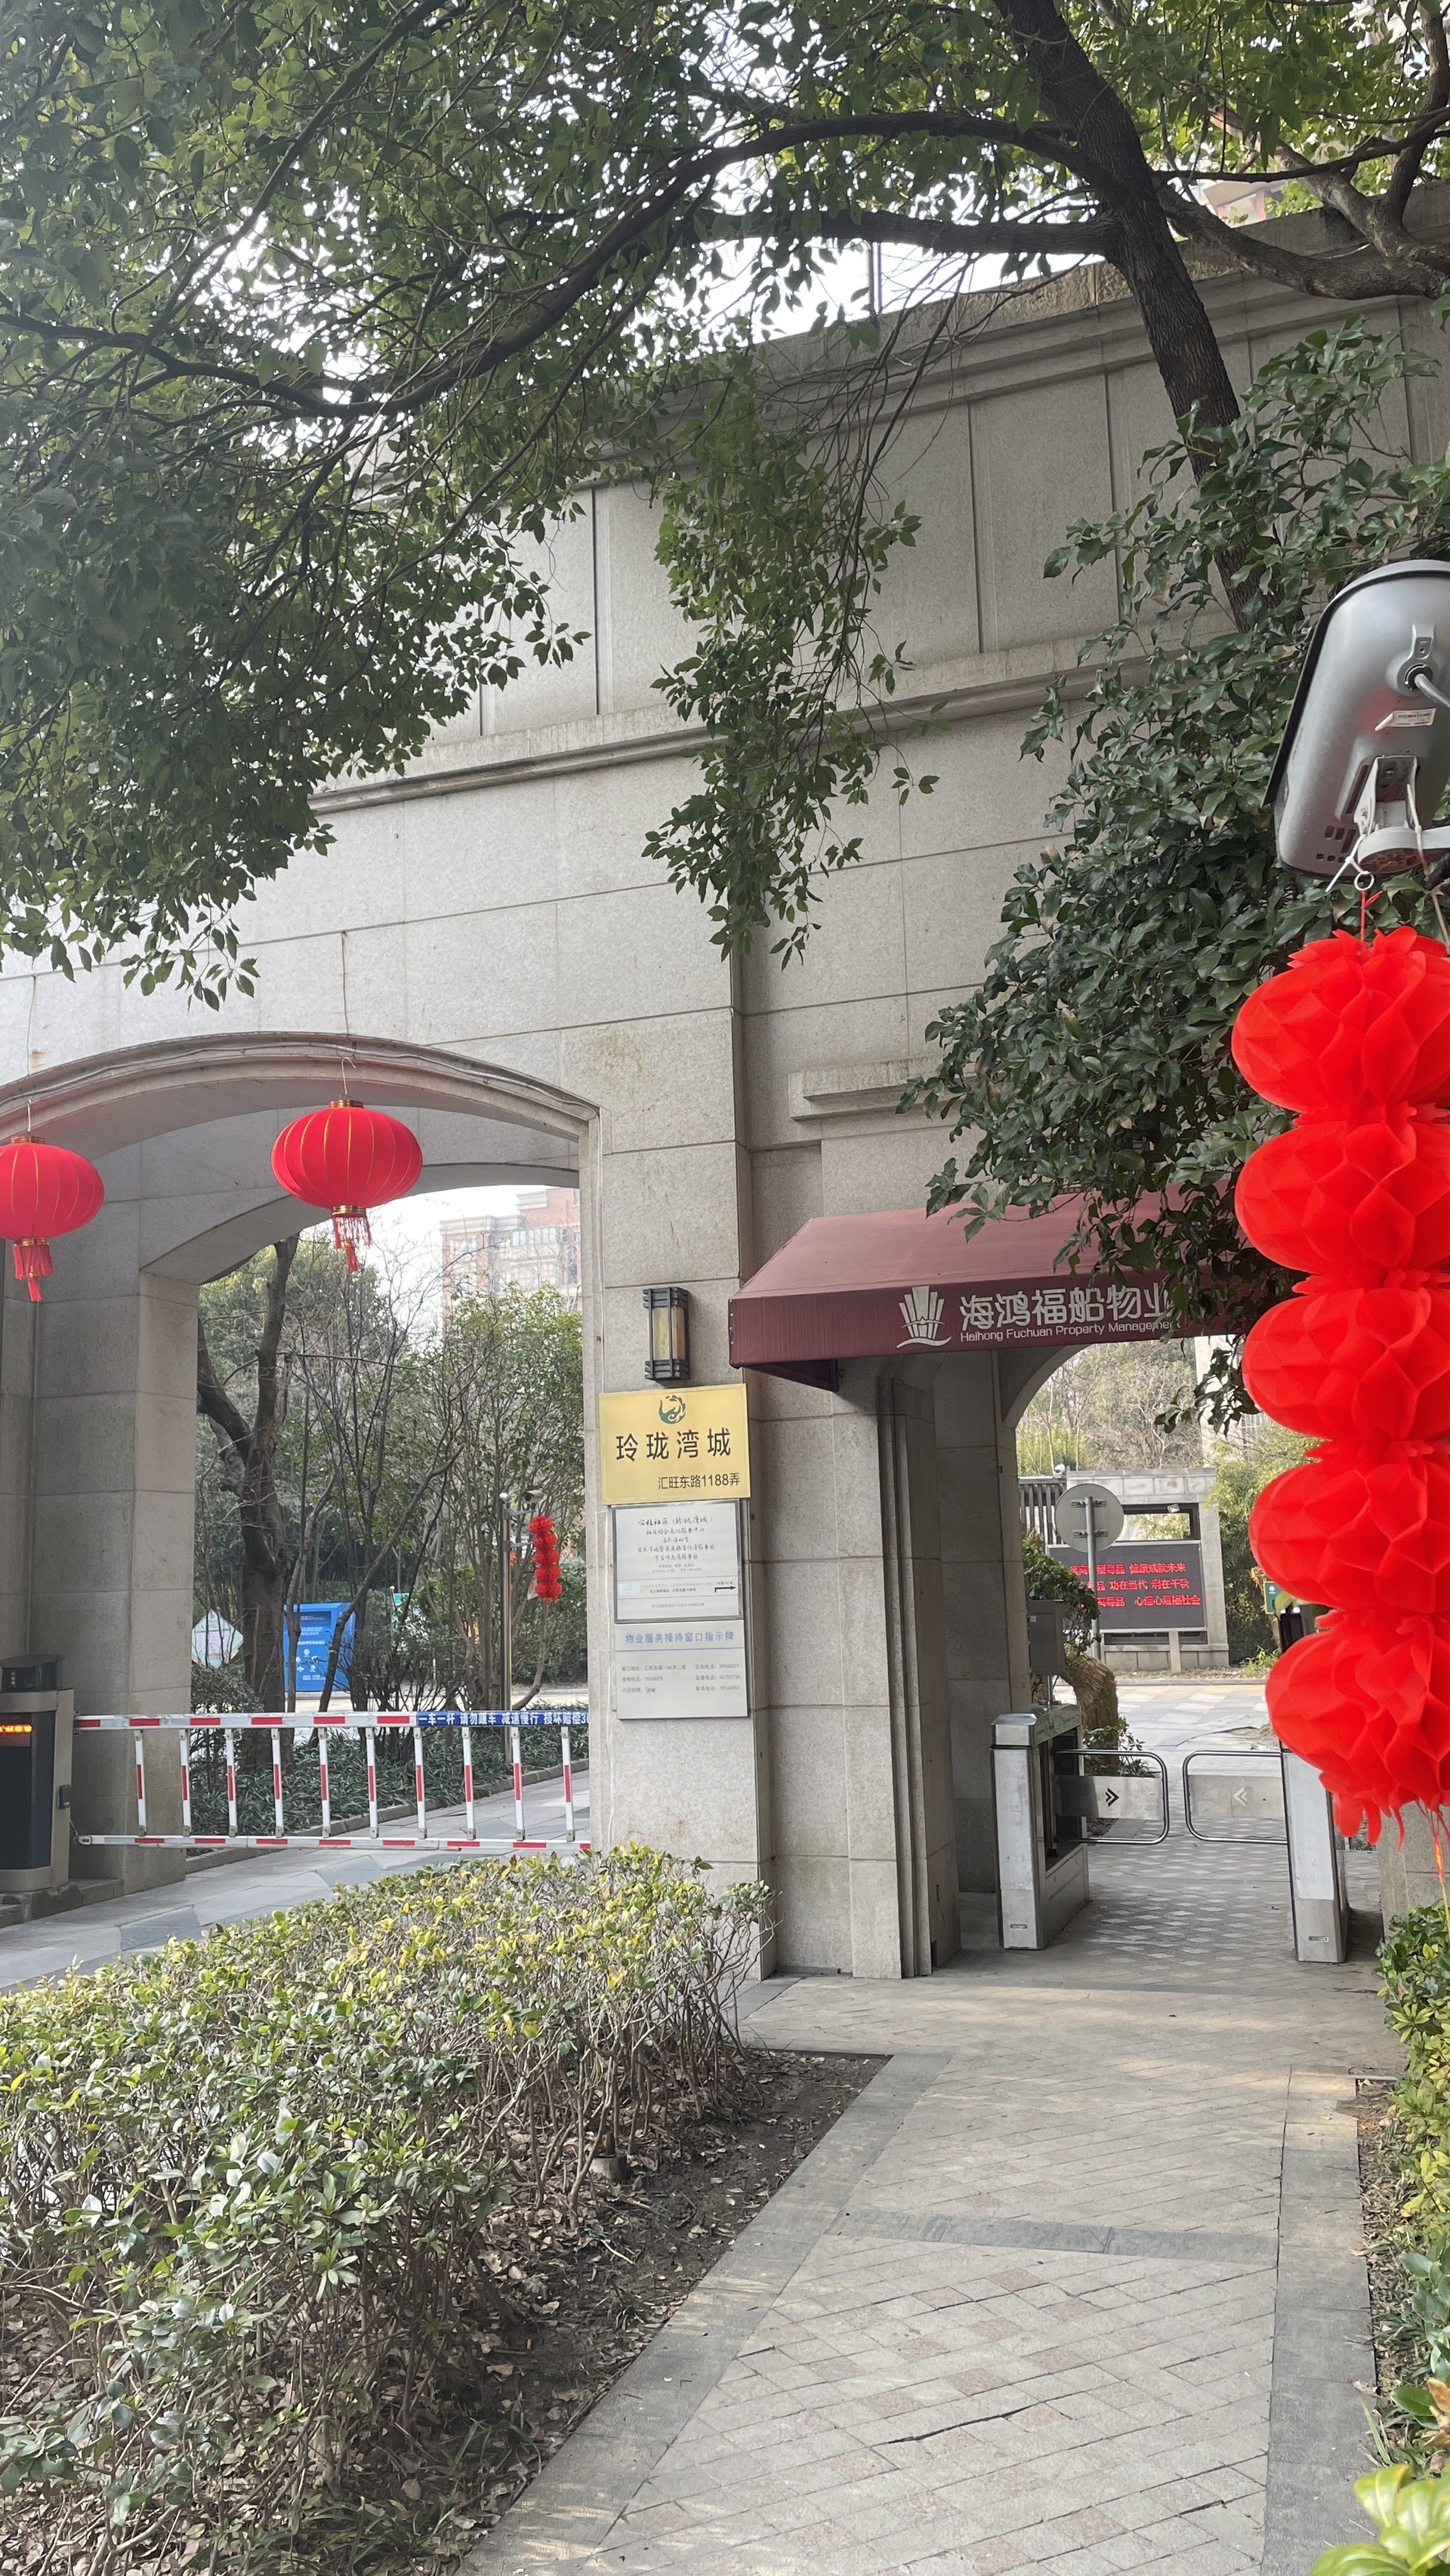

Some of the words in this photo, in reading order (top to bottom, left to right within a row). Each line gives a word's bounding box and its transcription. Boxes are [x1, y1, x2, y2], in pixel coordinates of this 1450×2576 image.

[959, 1282, 1171, 1331] 海鸿福船物业
[961, 1332, 1004, 1342] Haihong
[1007, 1327, 1053, 1339] Fuchuan
[1056, 1323, 1105, 1337] Property
[1108, 1320, 1181, 1333] Manageme
[615, 1427, 731, 1462] 玲珑湾城
[658, 1472, 740, 1490] 汇旺东路1188弄
[1109, 1577, 1149, 1591] 功在当代
[625, 1630, 735, 1644] 物业服务接待窗口指示牌
[418, 1712, 455, 1726] 一车一杆
[460, 1712, 497, 1725] 请勿跟车
[501, 1712, 539, 1725] 减速慢行
